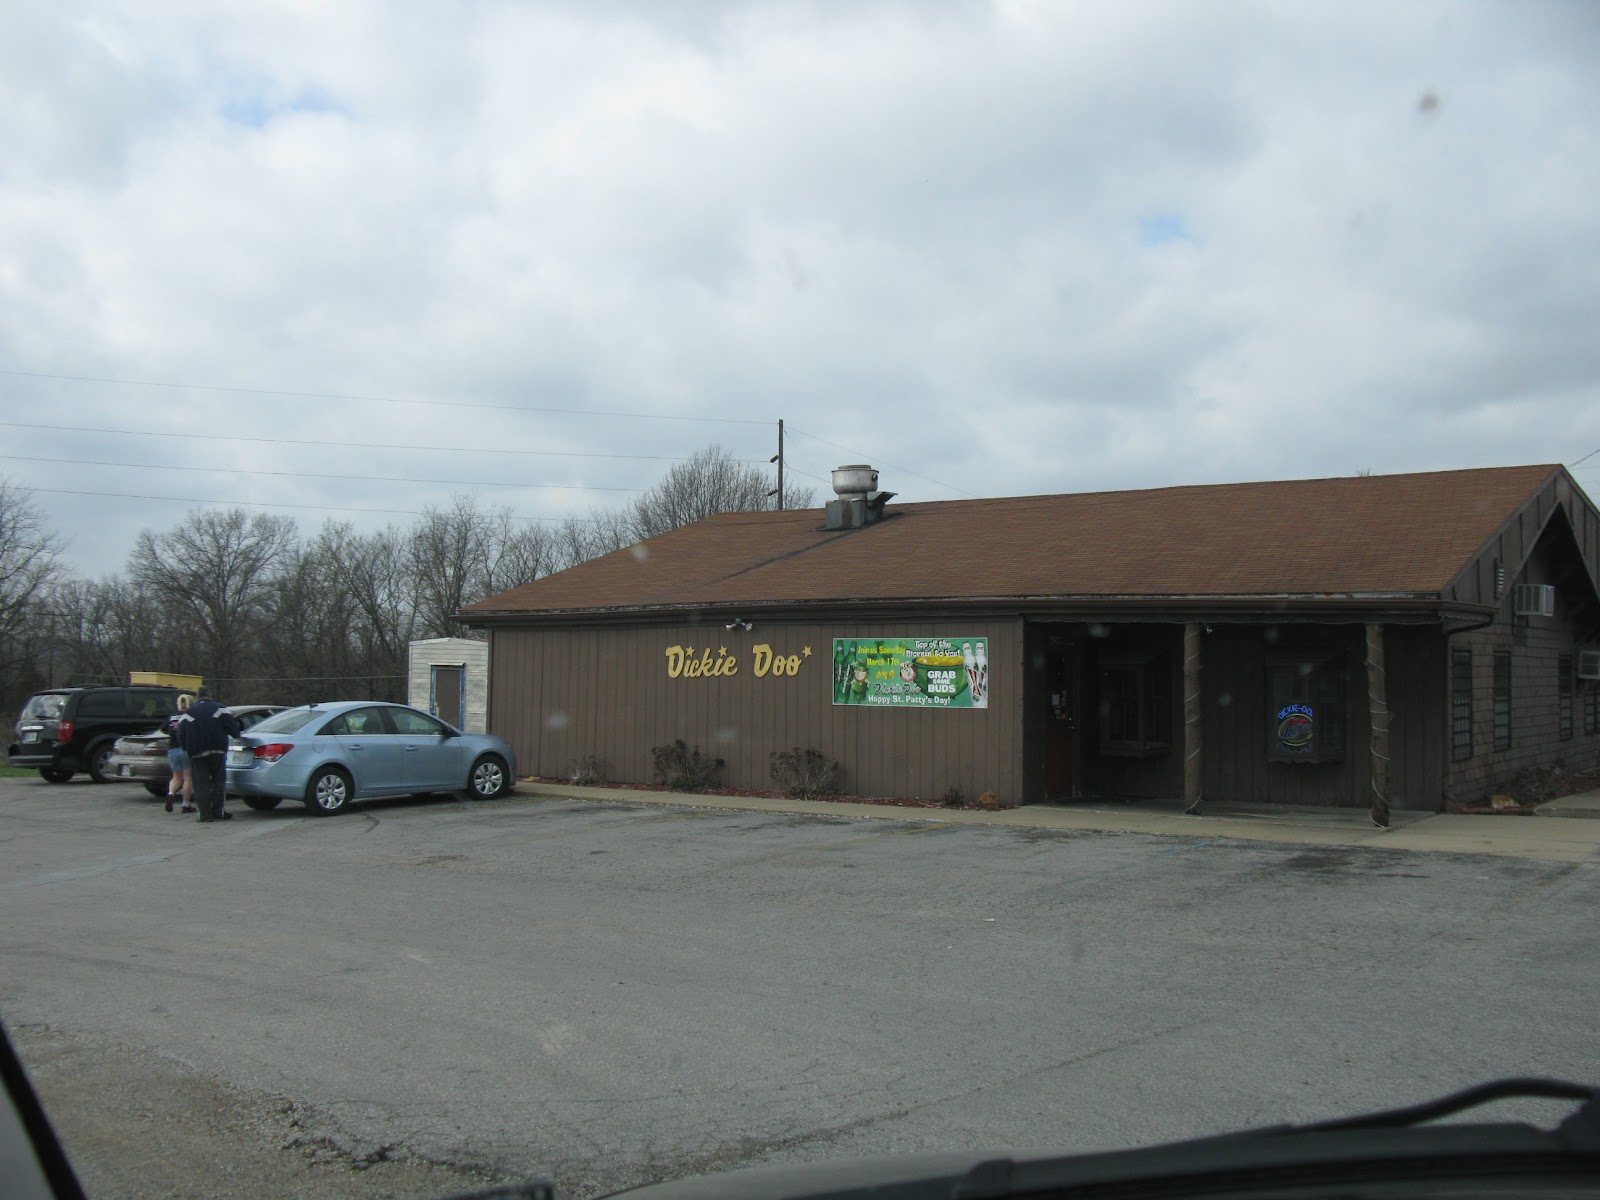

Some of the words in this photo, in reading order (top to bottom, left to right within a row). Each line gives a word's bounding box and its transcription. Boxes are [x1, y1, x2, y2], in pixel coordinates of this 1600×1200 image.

[915, 640, 928, 650] Top
[938, 640, 952, 648] the
[857, 646, 869, 654] Join
[878, 646, 905, 656] Saturday
[665, 645, 739, 678] Dickie
[752, 643, 802, 678] Doo
[867, 658, 885, 666] March
[887, 658, 900, 666] 17th
[927, 670, 956, 679] GRAB
[927, 684, 956, 693] BUDS
[868, 694, 891, 705] Happy
[892, 695, 904, 703] St.
[905, 695, 932, 705] Patty's
[934, 696, 951, 706] Day!
